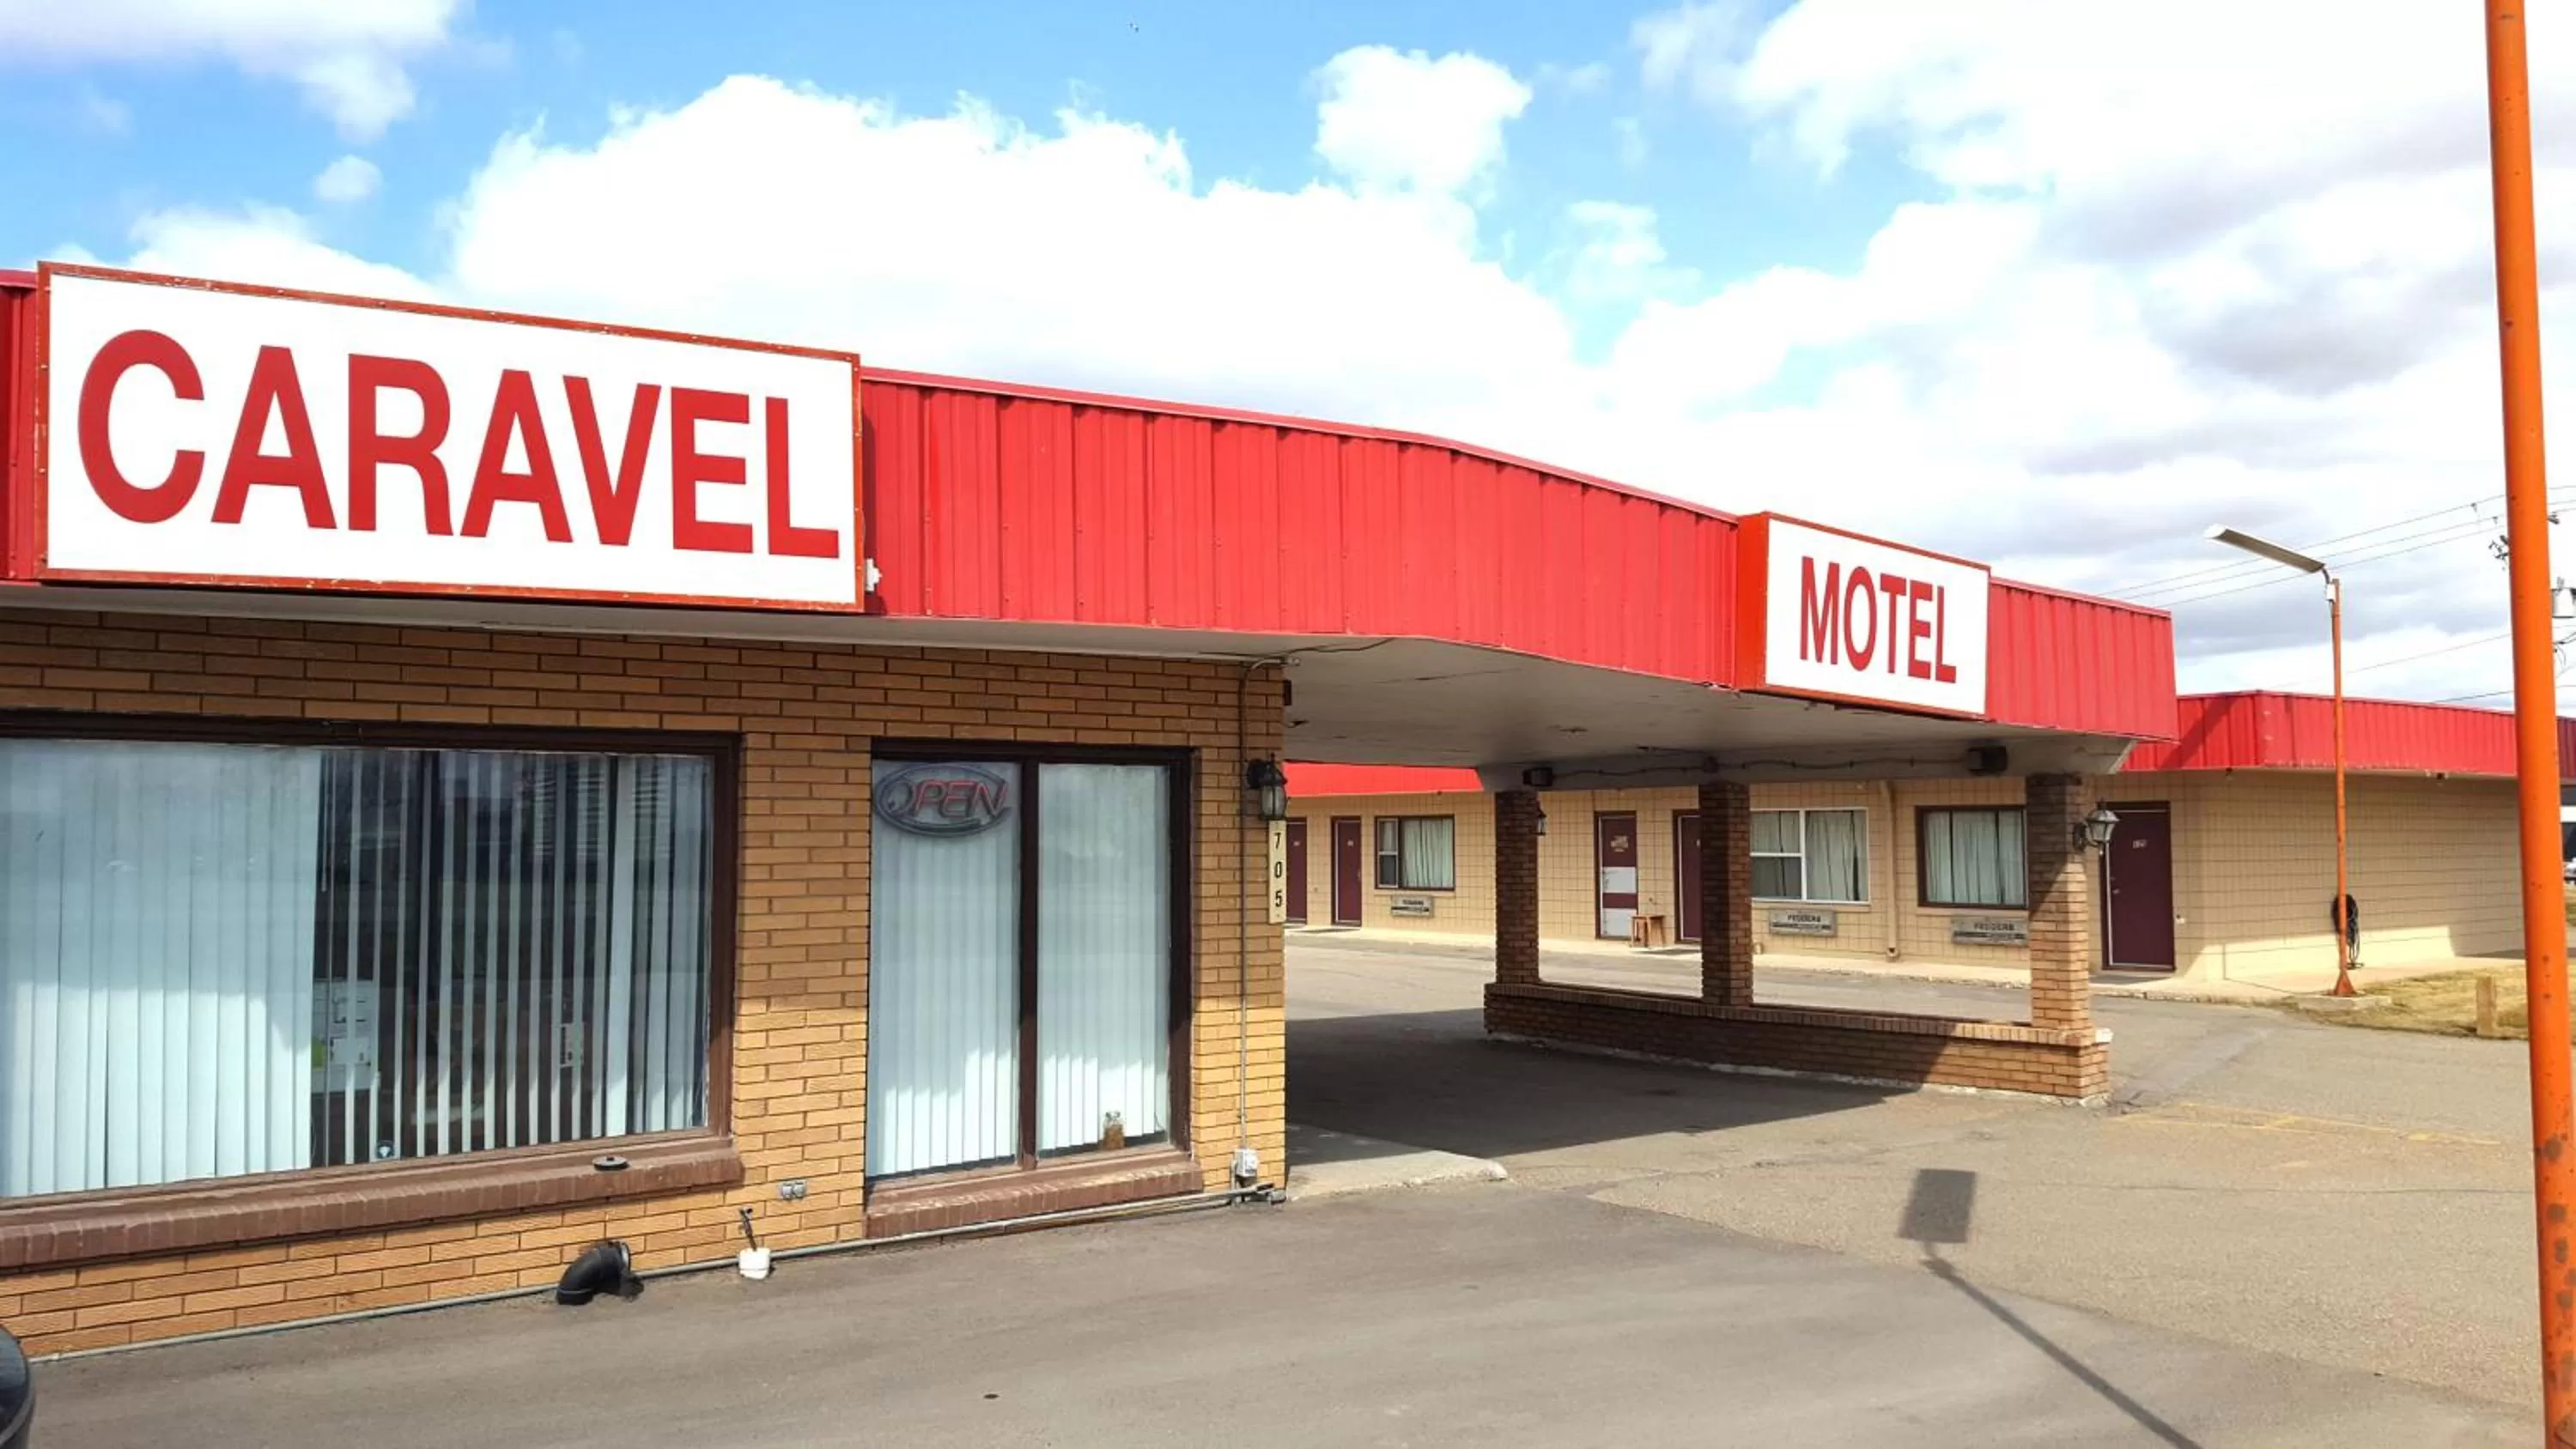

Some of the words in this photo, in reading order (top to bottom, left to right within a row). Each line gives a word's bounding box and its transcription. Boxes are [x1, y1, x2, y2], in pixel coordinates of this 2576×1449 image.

[77, 328, 840, 560] CARAVEL
[1800, 555, 1957, 684] MOTEL
[885, 777, 1009, 818] OPEN
[1274, 832, 1283, 908] 705
